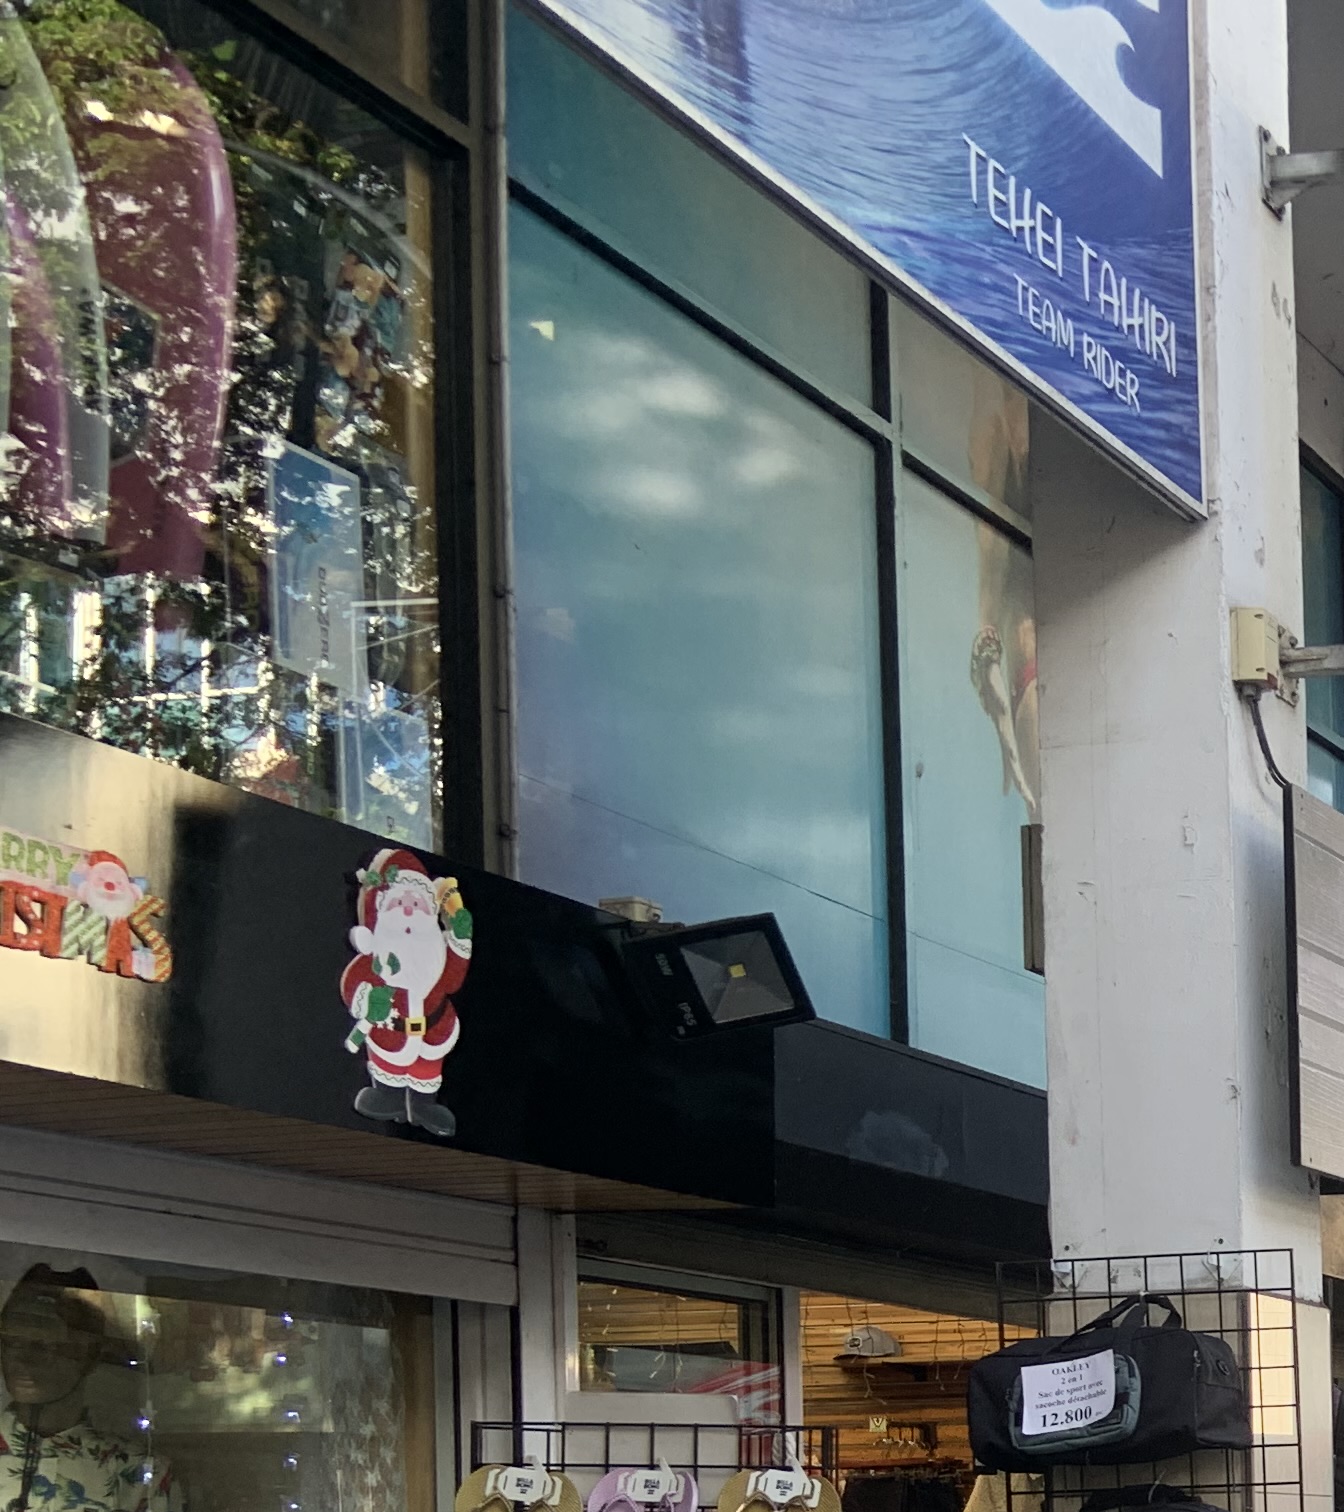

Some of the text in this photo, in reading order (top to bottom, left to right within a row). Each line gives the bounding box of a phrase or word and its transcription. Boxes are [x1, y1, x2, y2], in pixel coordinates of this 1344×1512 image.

[962, 132, 1177, 378] TEHEI TAHIRI
[1013, 272, 1142, 414] TEAM RIDER
[1052, 1362, 1091, 1376] OAKLEY
[1038, 1391, 1053, 1399] Sac
[1055, 1386, 1064, 1396] de
[1066, 1382, 1087, 1396] sport
[1061, 1377, 1066, 1385] 2
[1035, 1388, 1107, 1410] sacoche détachable
[1041, 1405, 1092, 1428] 12.800
